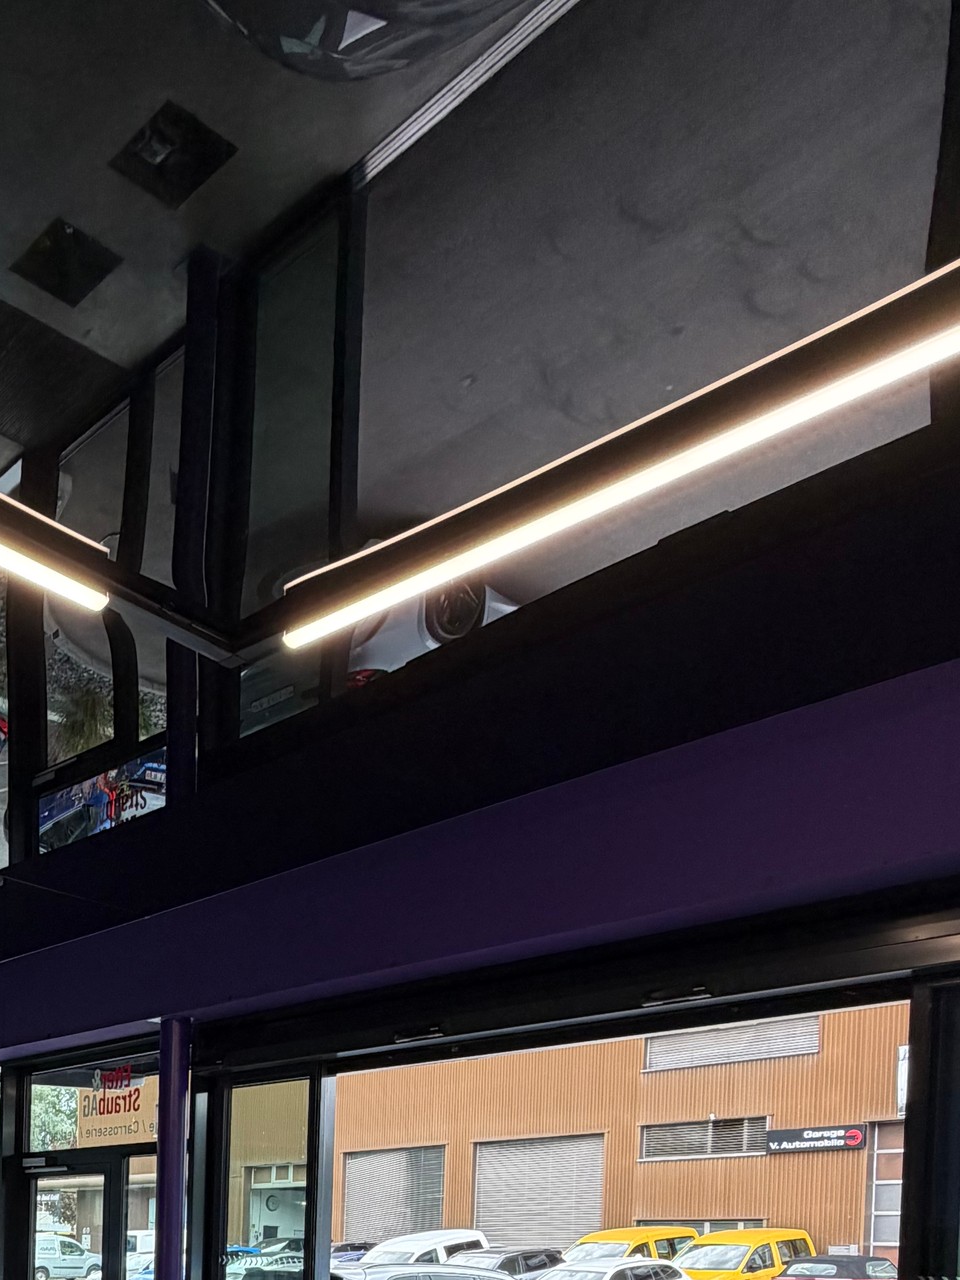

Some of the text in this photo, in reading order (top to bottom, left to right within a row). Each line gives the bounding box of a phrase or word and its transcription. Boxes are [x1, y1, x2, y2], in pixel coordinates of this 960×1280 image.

[803, 1129, 845, 1138] Garage
[769, 1139, 844, 1150] V. Automobile
